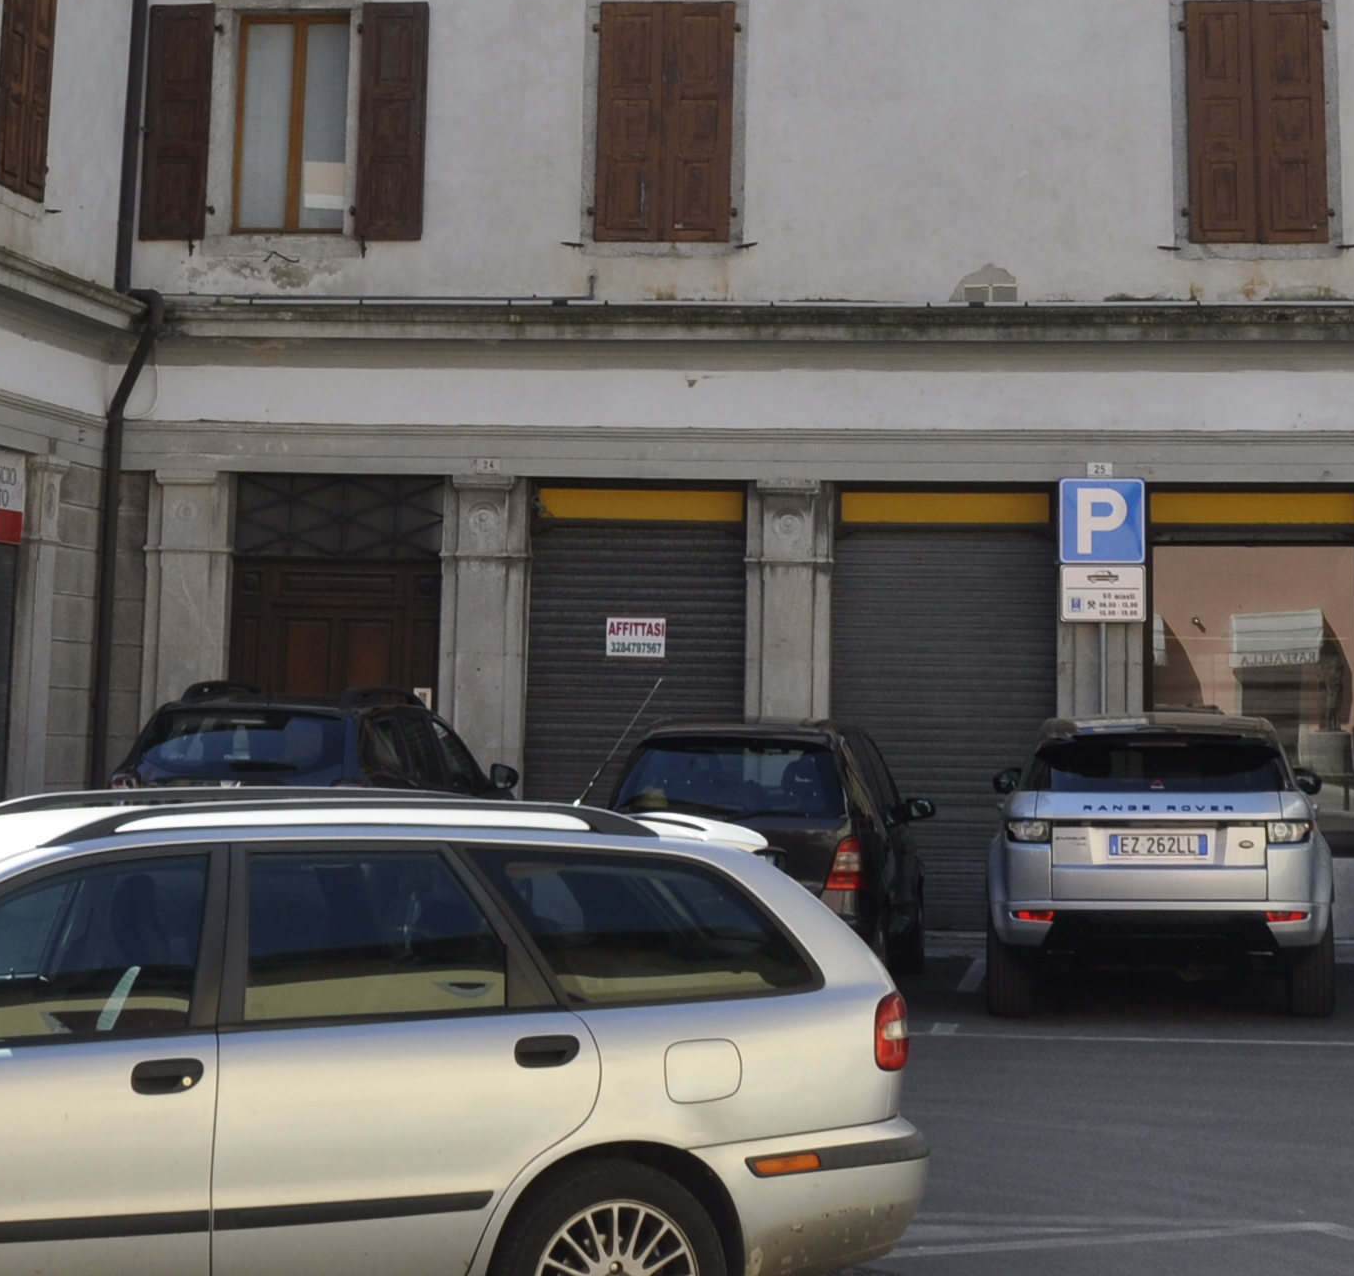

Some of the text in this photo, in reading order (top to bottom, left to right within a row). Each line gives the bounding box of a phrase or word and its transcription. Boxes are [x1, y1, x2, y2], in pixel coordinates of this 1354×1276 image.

[1094, 464, 1106, 474] 25
[1077, 487, 1127, 555] P
[608, 621, 665, 637] AFFITTASI
[610, 641, 662, 654] 3284797567
[1083, 804, 1234, 812] RANGE ROVER
[1120, 837, 1140, 854] EZ
[1146, 837, 1196, 854] 262LL
